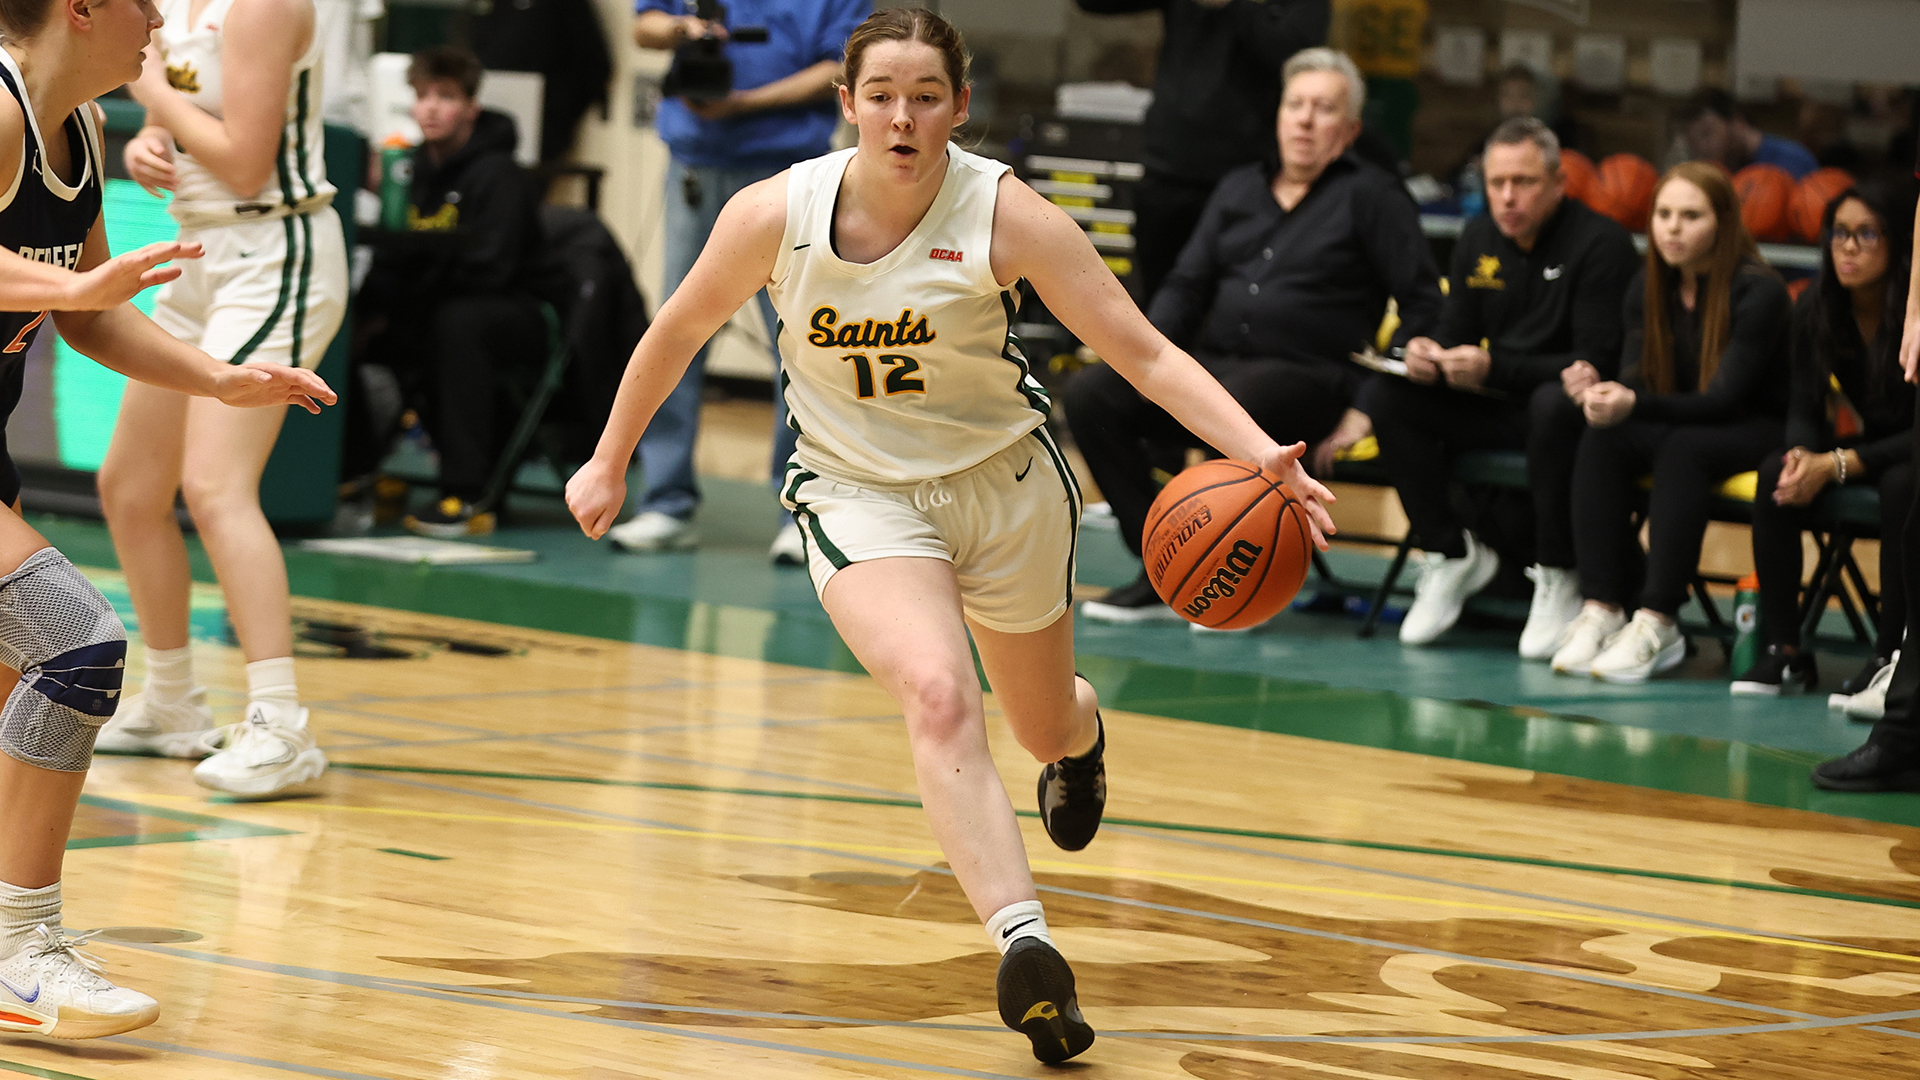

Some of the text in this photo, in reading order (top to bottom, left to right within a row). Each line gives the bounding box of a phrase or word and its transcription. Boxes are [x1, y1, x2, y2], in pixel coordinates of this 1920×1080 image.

[929, 248, 963, 262] OCAA
[807, 305, 937, 348] Saints
[839, 352, 926, 400] 12
[1153, 509, 1213, 588] EVOLUTION
[1182, 539, 1263, 618] Wilson
